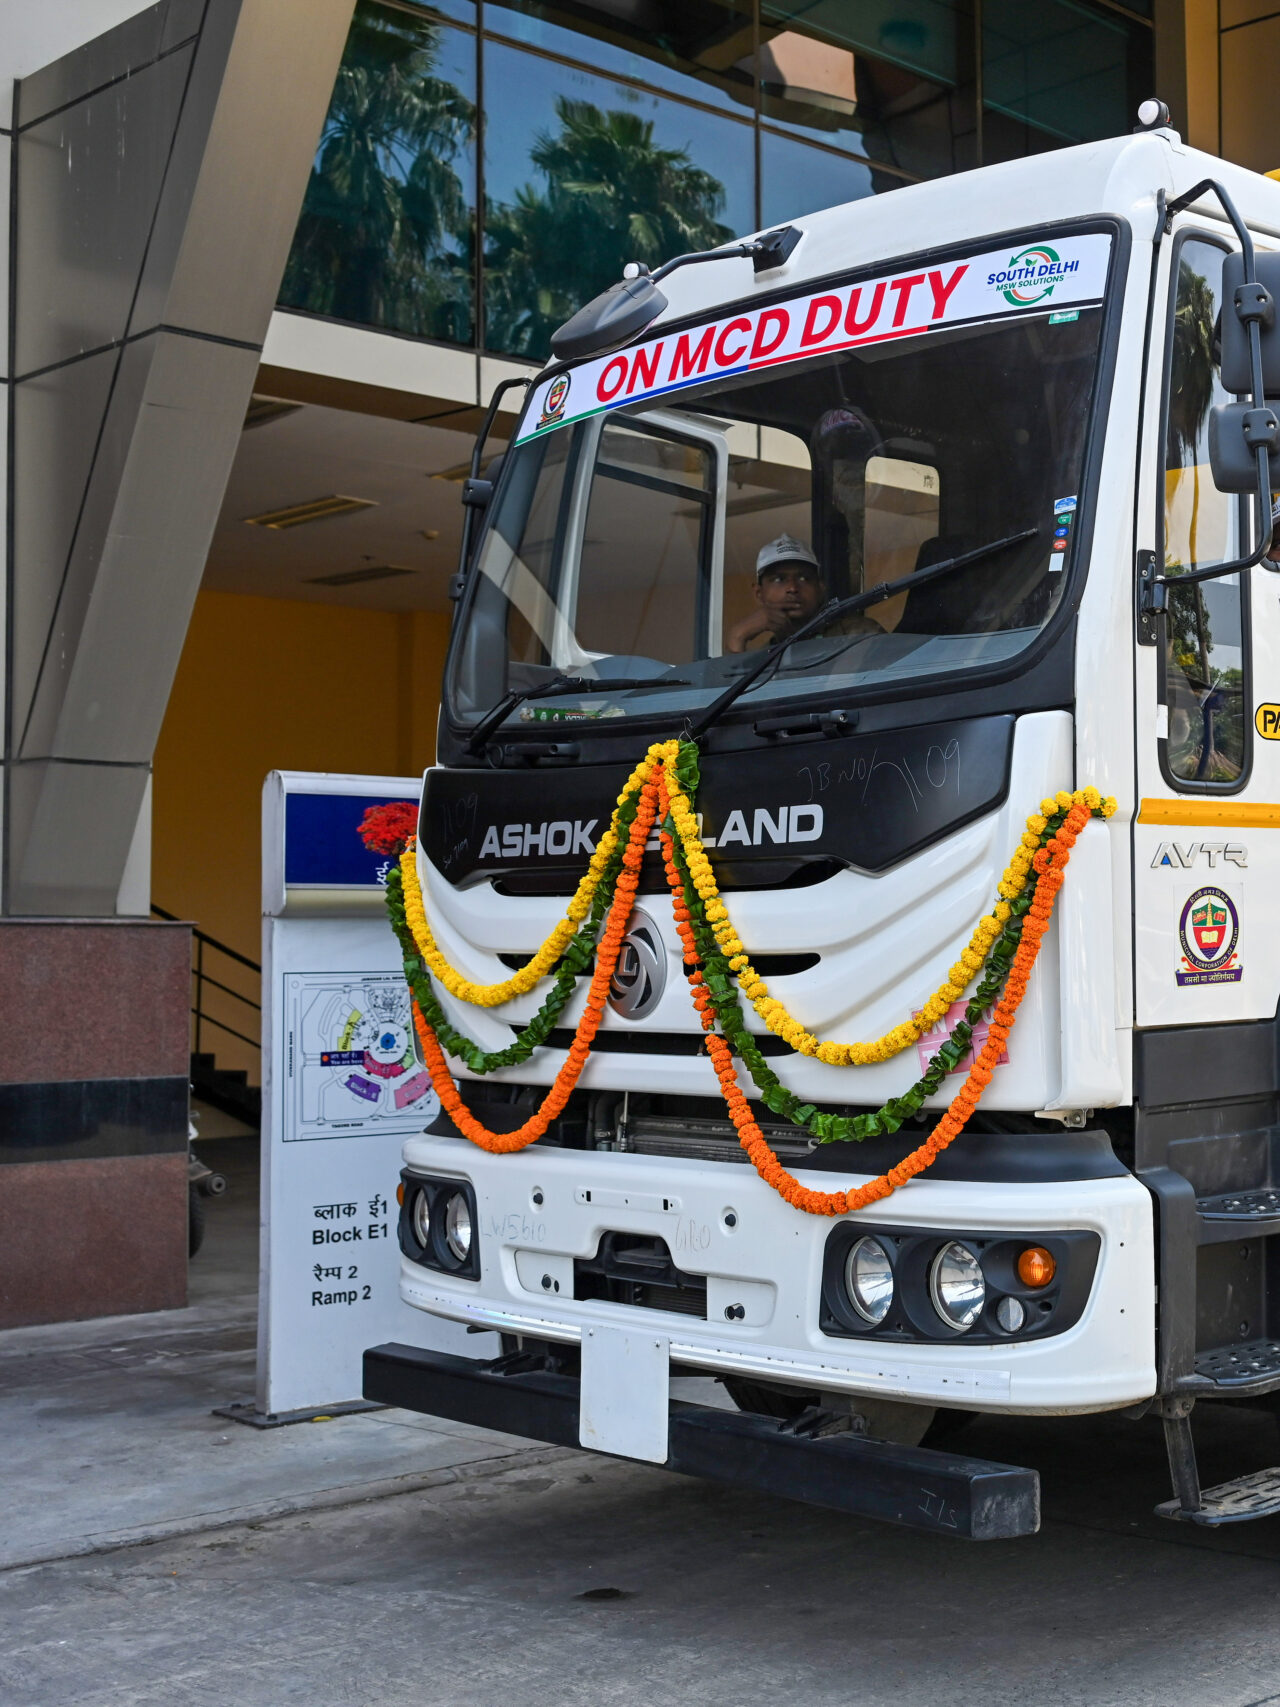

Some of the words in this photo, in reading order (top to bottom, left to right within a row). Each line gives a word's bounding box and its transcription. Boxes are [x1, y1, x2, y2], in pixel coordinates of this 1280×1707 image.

[987, 266, 1036, 285] SOUTH
[1037, 260, 1080, 277] DELHI
[995, 282, 1017, 291] MSW
[1018, 275, 1064, 288] SOLUTIONS
[596, 342, 665, 402] ON
[667, 308, 790, 382] MCD
[799, 264, 970, 348] DUTY
[478, 819, 600, 858] ASHOK
[1151, 842, 1248, 868] AVTR
[1180, 930, 1195, 963] MUNICIPAL
[1195, 956, 1228, 969] CORPORATION
[313, 1202, 358, 1220] ब्लाक
[368, 1194, 387, 1218] ई1
[312, 1226, 362, 1245] Block
[368, 1223, 387, 1239] E1
[312, 1263, 342, 1282] रैम्प
[348, 1266, 358, 1279] 2
[312, 1289, 357, 1306] Ramp
[362, 1285, 371, 1300] 2
